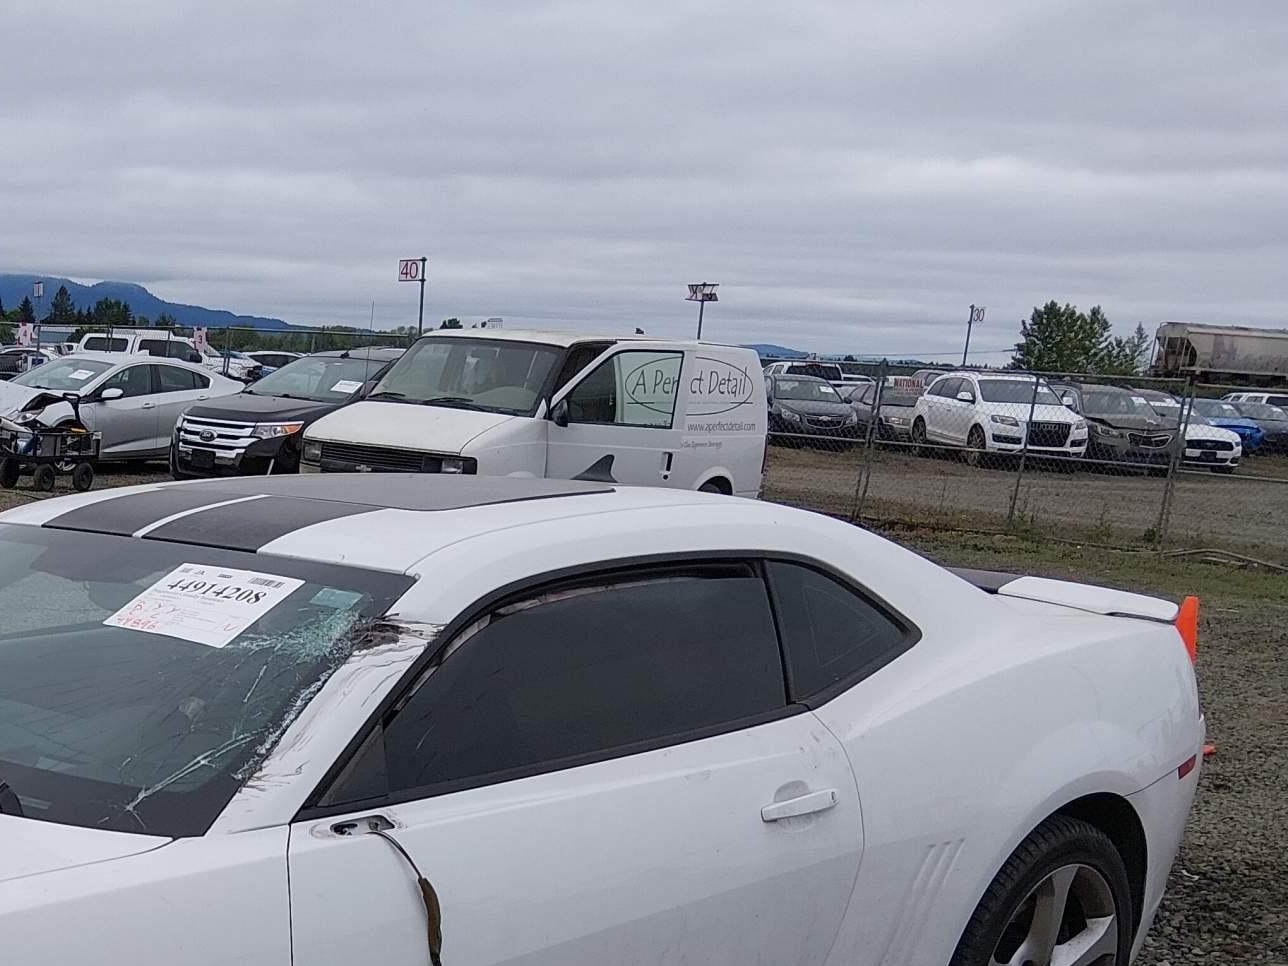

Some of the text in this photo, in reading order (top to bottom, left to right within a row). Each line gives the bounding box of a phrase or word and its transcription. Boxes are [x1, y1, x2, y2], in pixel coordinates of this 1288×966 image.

[400, 261, 419, 279] 40
[973, 308, 985, 322] 30
[631, 366, 748, 397] A Perct Detail
[687, 421, 756, 433] www.aperfectdetail.com
[167, 578, 267, 606] 44914208
